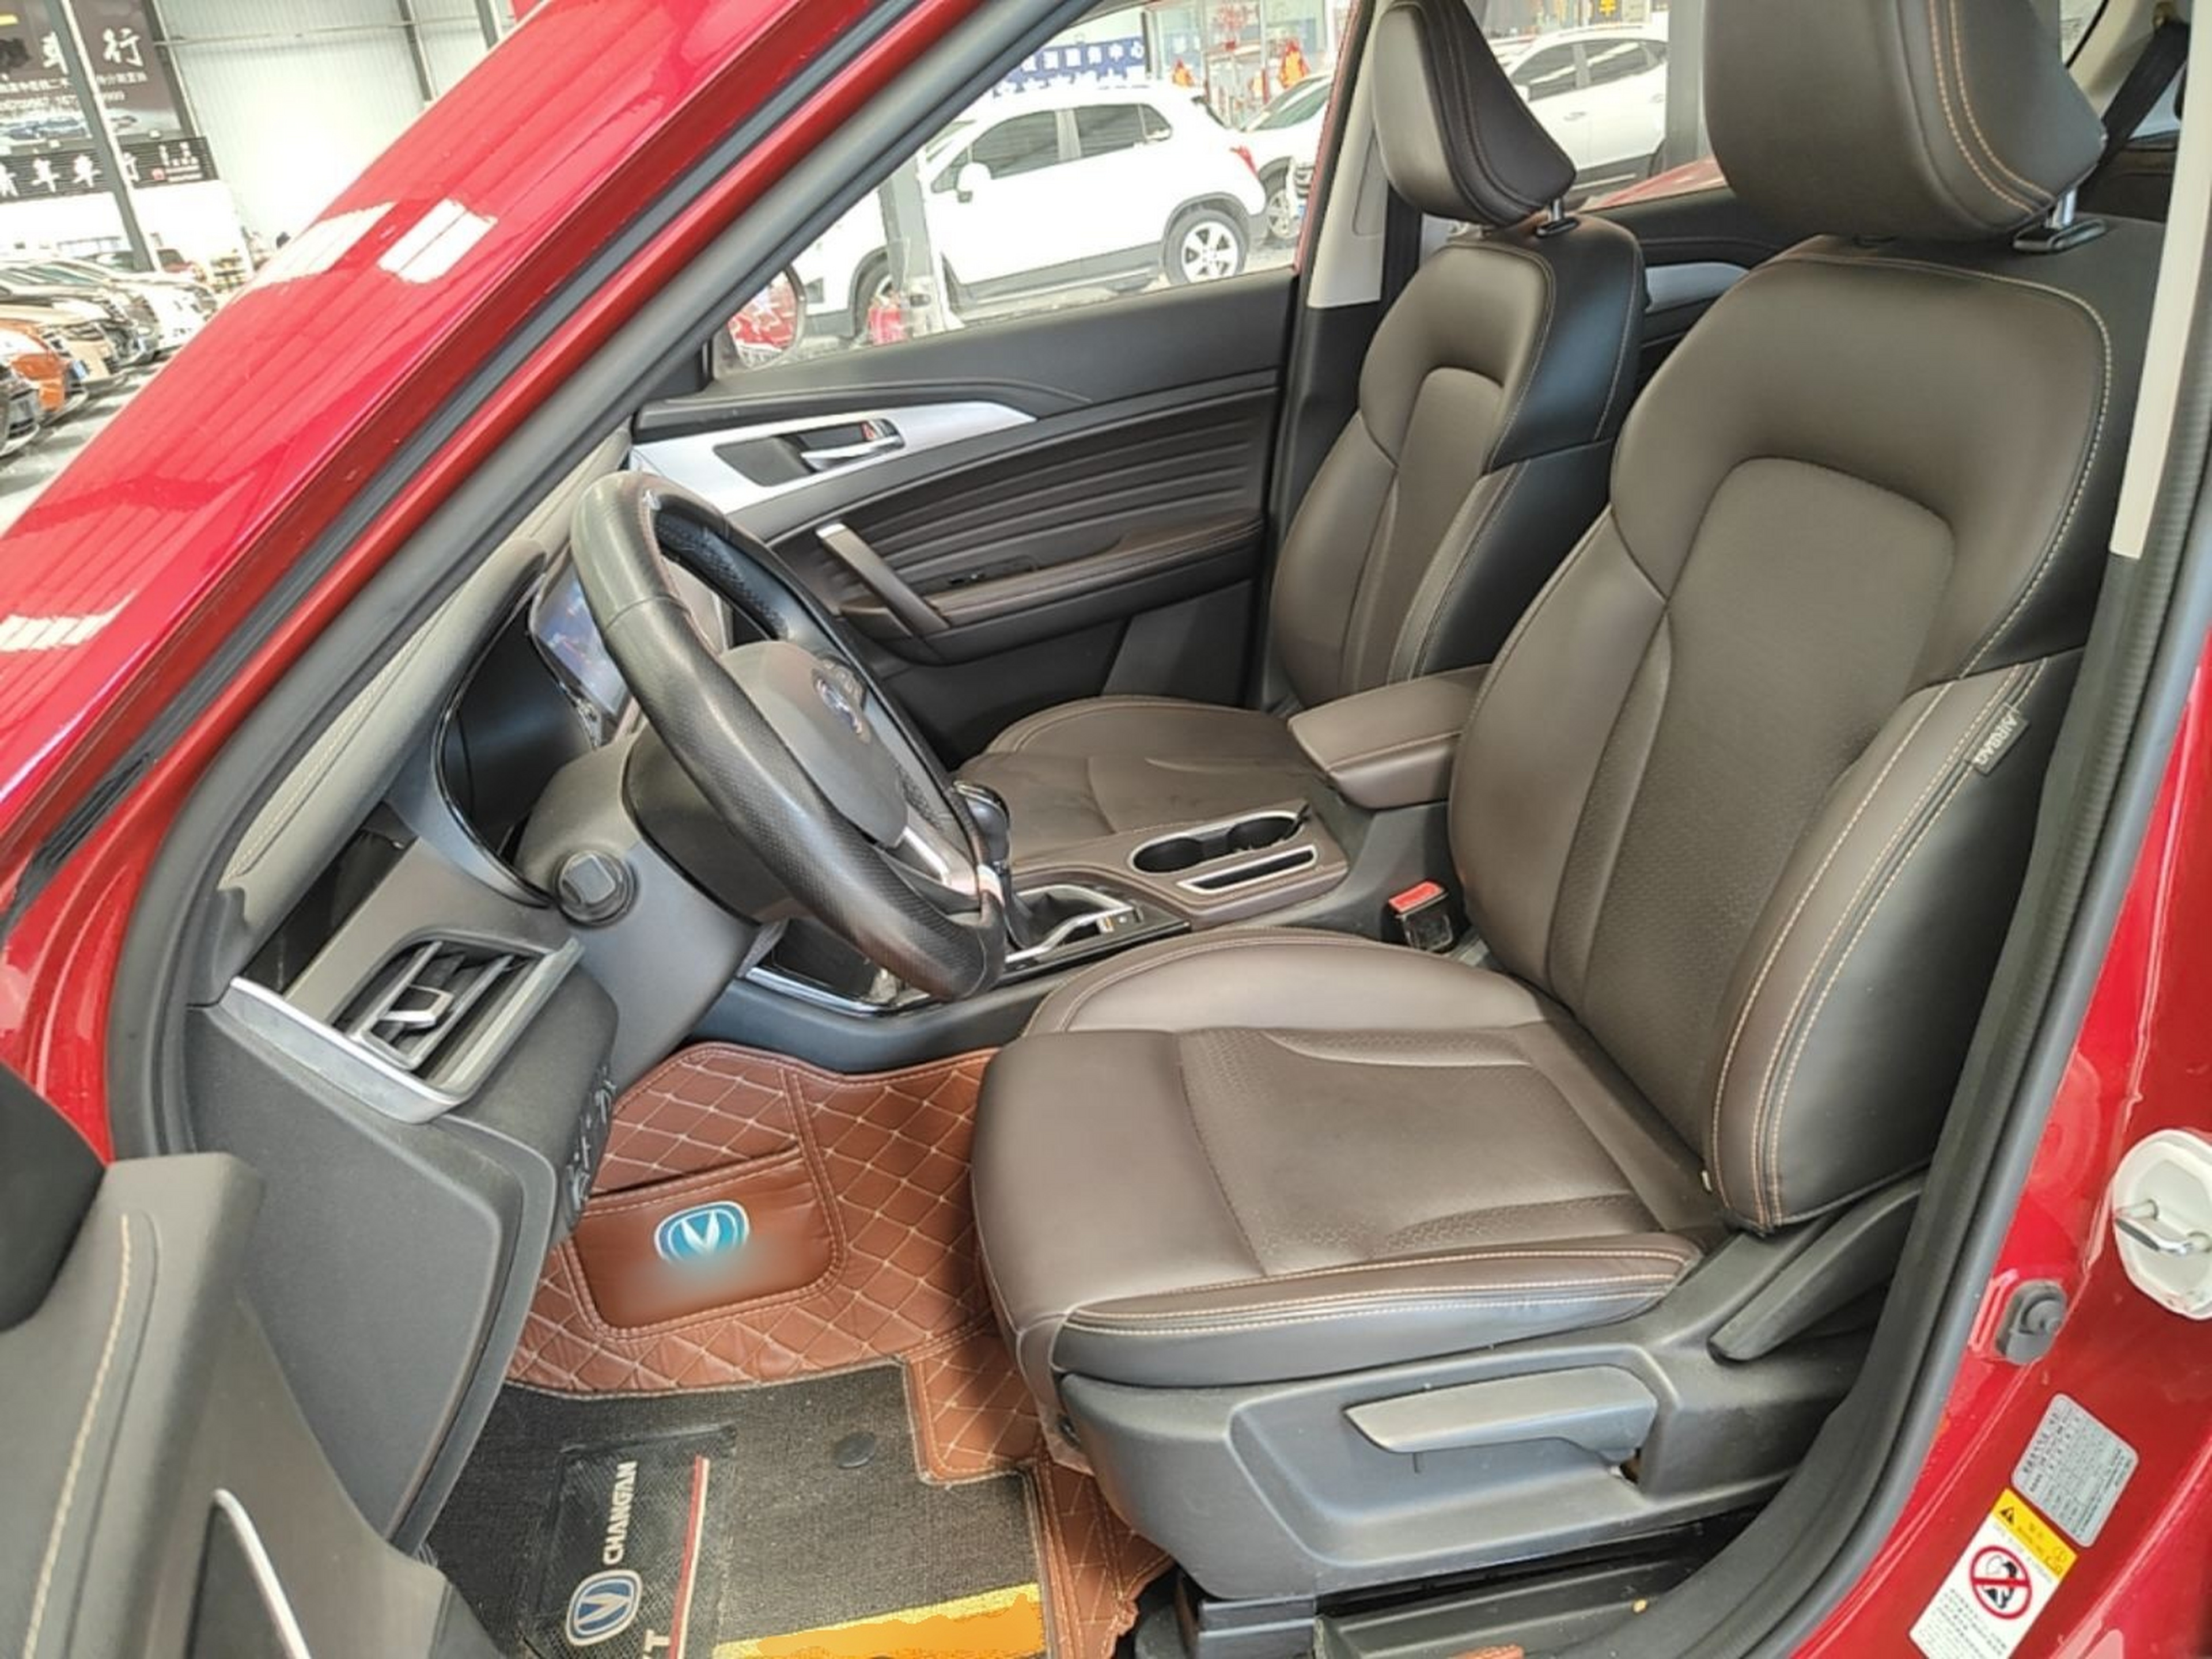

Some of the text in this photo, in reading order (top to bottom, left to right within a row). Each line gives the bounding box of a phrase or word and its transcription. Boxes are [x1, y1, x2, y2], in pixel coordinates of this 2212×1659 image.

[1972, 709, 2017, 765] AIRBAG
[603, 1460, 638, 1565] CHANGAN
[642, 1628, 671, 1659] T
